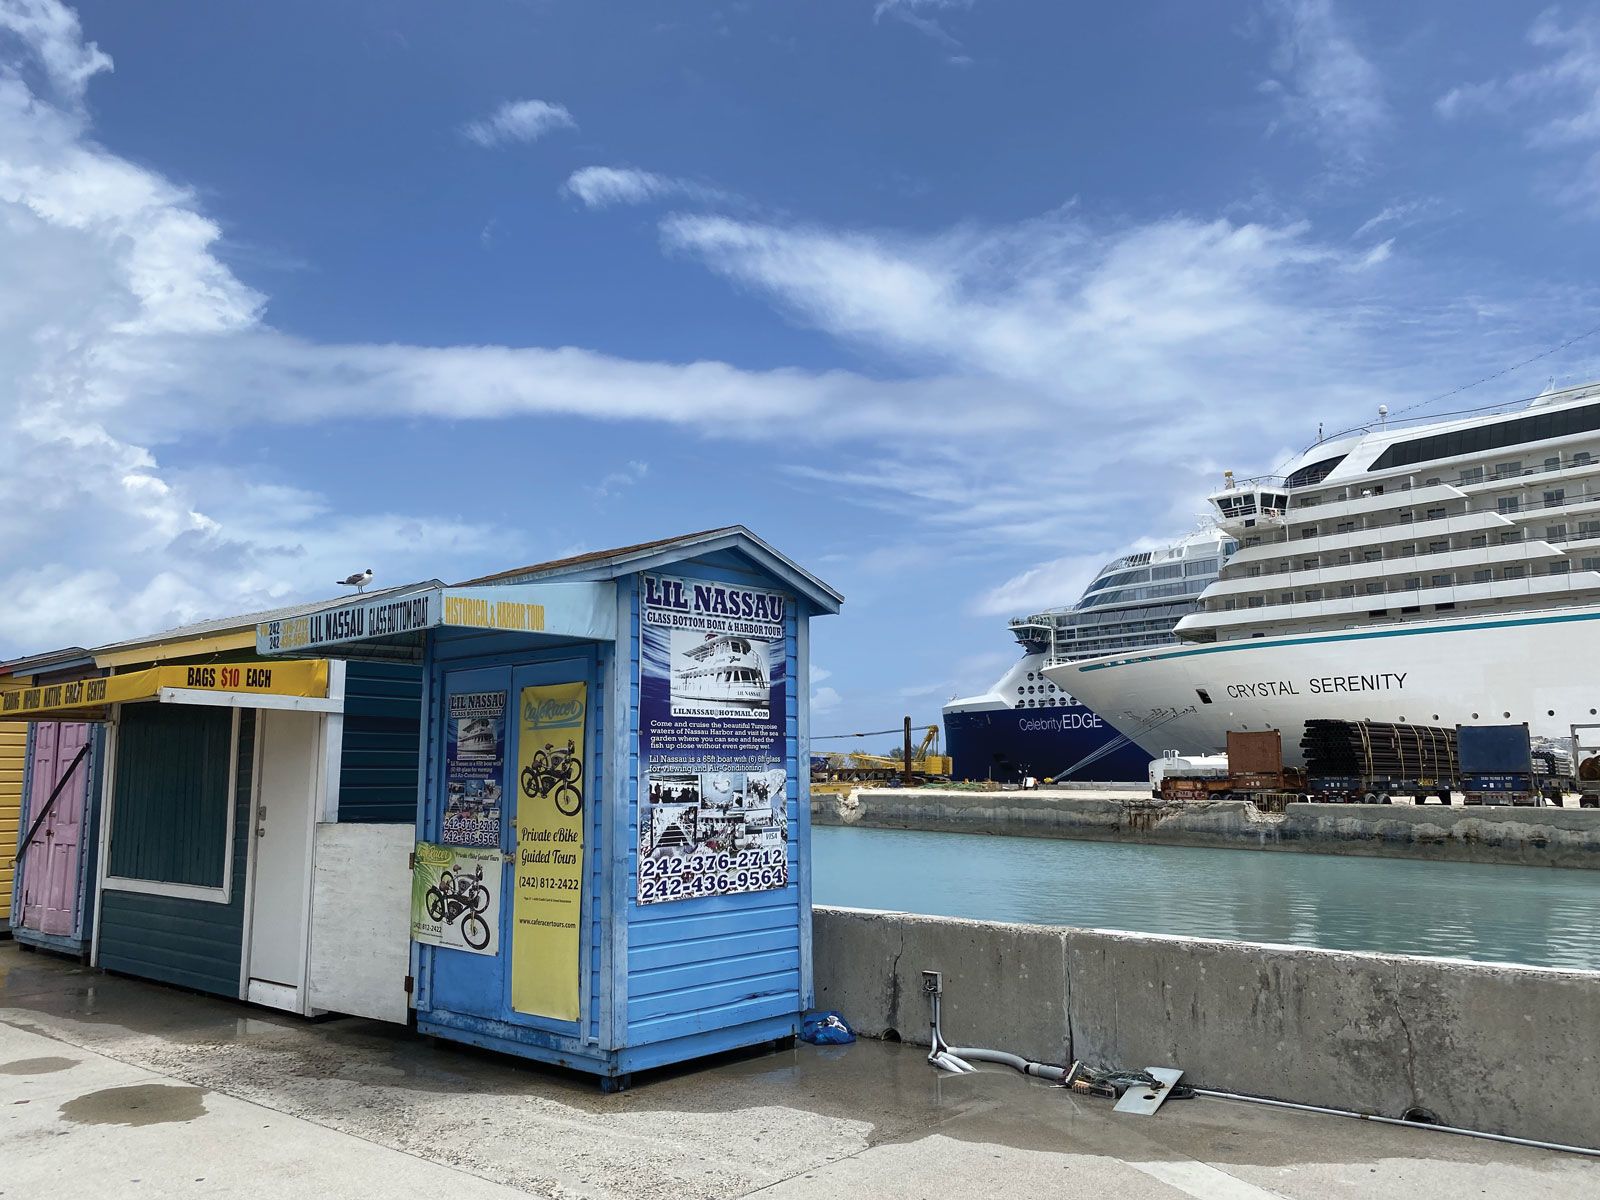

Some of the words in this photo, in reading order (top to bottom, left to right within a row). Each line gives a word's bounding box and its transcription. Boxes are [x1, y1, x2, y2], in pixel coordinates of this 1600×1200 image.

[645, 577, 689, 609] LIL
[694, 585, 783, 620] NASSAU
[310, 615, 323, 643] LIL
[326, 608, 364, 640] NASSAU
[368, 606, 386, 636] GLASS
[388, 599, 411, 632] BOTTOM
[413, 597, 429, 628] BOAT
[445, 596, 488, 627] HISTORICAL
[496, 601, 525, 629] HARBOR
[526, 603, 545, 631] TOUR
[646, 611, 671, 624] GLASS
[672, 615, 705, 628] BOTTOM
[706, 619, 726, 631] BOAT
[727, 621, 733, 631] &
[734, 622, 764, 634] HARBOR
[764, 626, 782, 637] TOUR
[187, 667, 216, 687] BAGS
[221, 667, 240, 688] $10
[246, 668, 272, 688] EACH
[1226, 681, 1300, 698] CRYSTAL
[1309, 673, 1407, 693] SERENITY
[44, 686, 61, 707] NATIVE
[87, 679, 106, 702] CENTER
[451, 696, 466, 709] LIL
[468, 693, 505, 709] NASSAU
[751, 723, 777, 731] Turquoise
[650, 735, 677, 743] garden
[734, 755, 747, 763] with
[765, 756, 781, 764] glass
[649, 764, 660, 772] for
[694, 764, 706, 772] and
[708, 764, 761, 773] Air-Conditioning
[444, 818, 499, 831] 242-376-2712
[444, 830, 499, 844] 242-436-9564
[521, 827, 551, 841] Private
[553, 827, 578, 842] eBike
[521, 848, 551, 866] Guided
[552, 849, 577, 864] Tours
[642, 849, 783, 877] 242-376-2712
[519, 876, 538, 889] (242)
[540, 877, 579, 890] 812-2422
[642, 868, 784, 899] 242-436-9564
[519, 918, 576, 929] www.caferacertours.com
